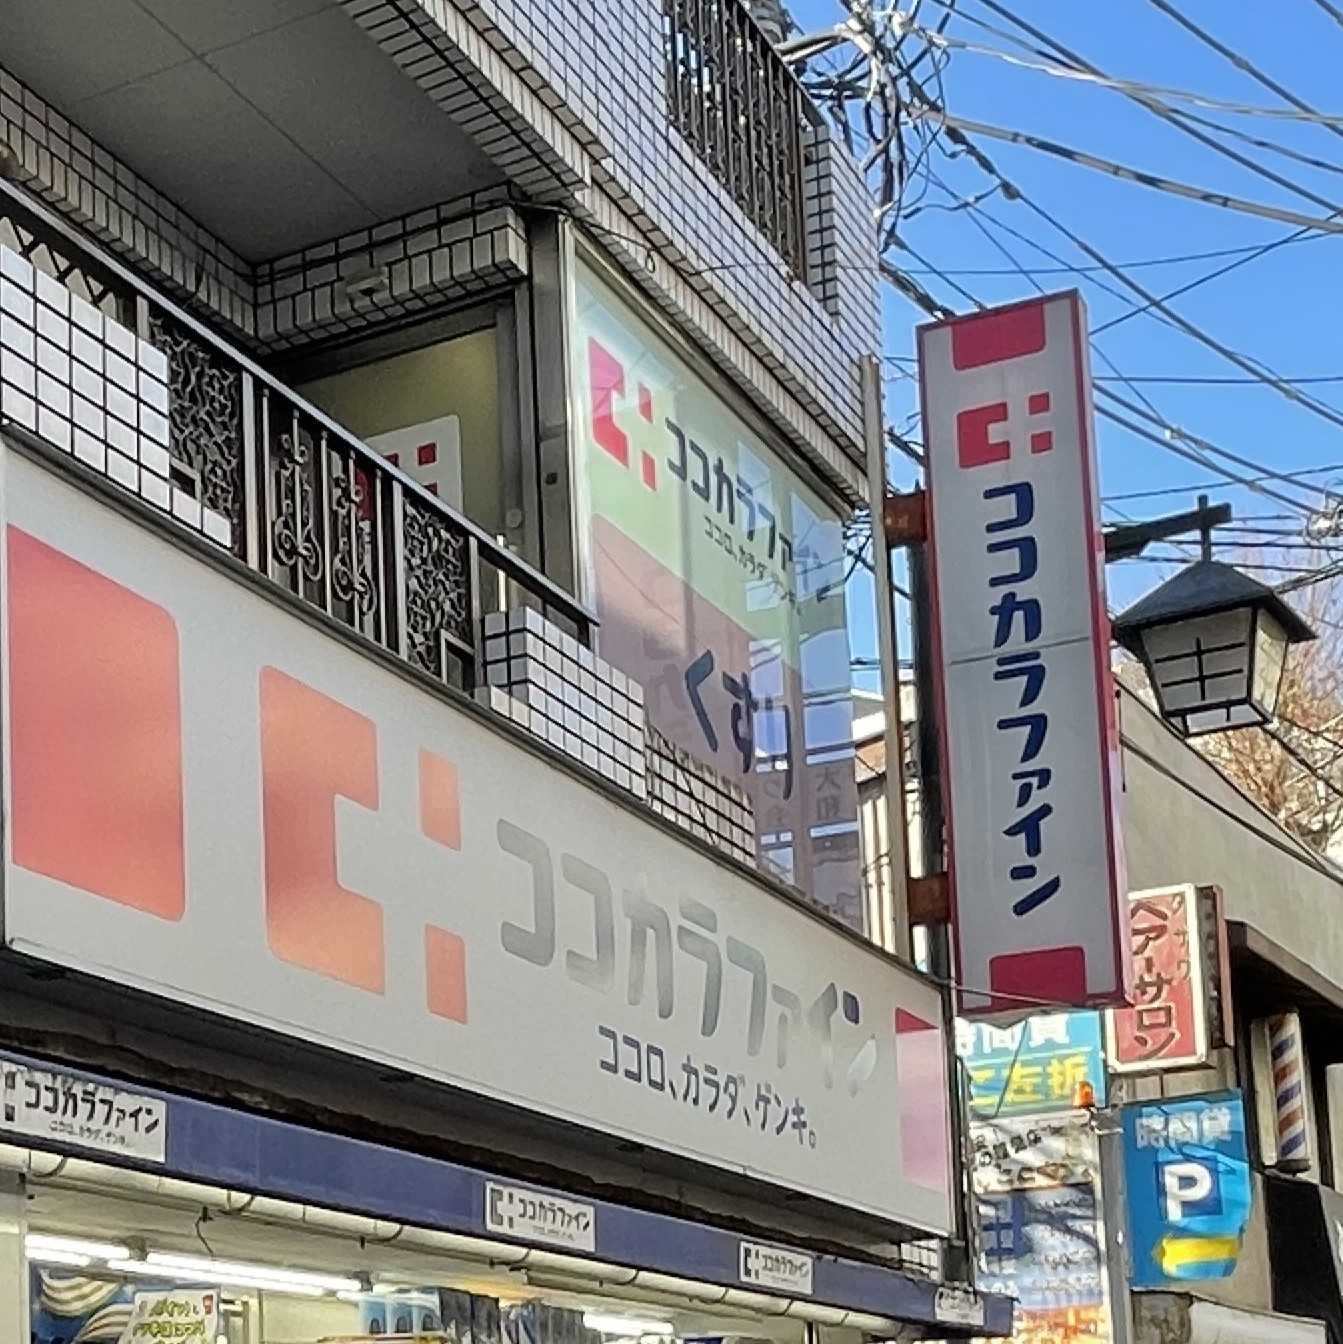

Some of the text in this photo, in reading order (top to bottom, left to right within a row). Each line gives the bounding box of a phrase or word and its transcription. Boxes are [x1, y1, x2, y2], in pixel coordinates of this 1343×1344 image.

[984, 481, 1061, 917] ココカラファイン
[496, 818, 878, 1098] ココカラファイン
[1130, 901, 1177, 1061] ヘアーサロン
[24, 1080, 160, 1135] ココカラファイン
[598, 1024, 817, 1150] ココロ、カラダ、ゲンキ。
[1164, 1162, 1213, 1222] P
